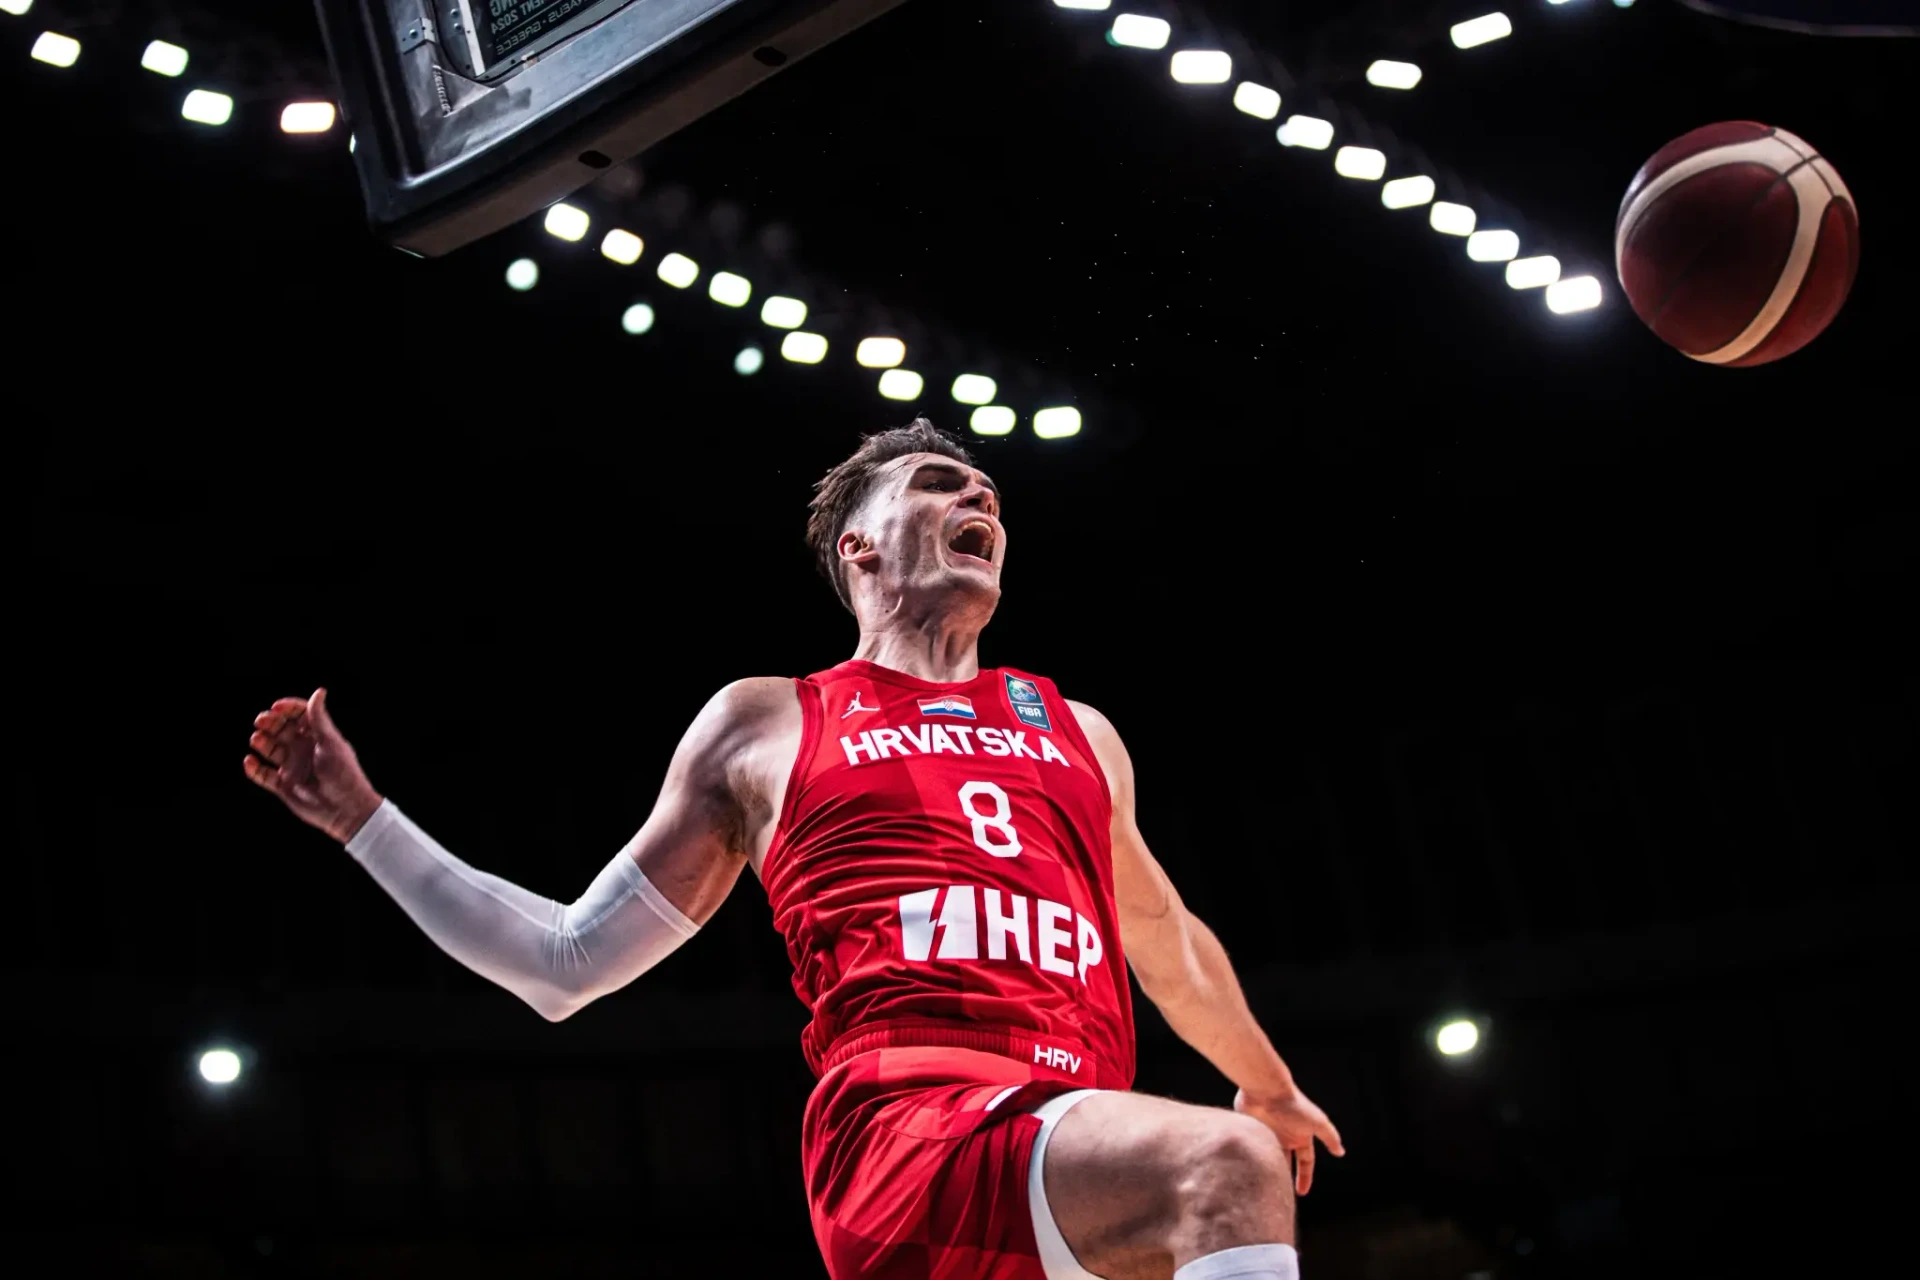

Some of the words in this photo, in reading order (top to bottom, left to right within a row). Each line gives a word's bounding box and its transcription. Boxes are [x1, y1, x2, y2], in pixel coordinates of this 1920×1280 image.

[1017, 705, 1042, 718] FIBA
[839, 723, 1071, 767] HRVATSKA
[957, 780, 1023, 858] 8
[983, 886, 1103, 986] HEP
[1033, 1043, 1082, 1075] HRV
